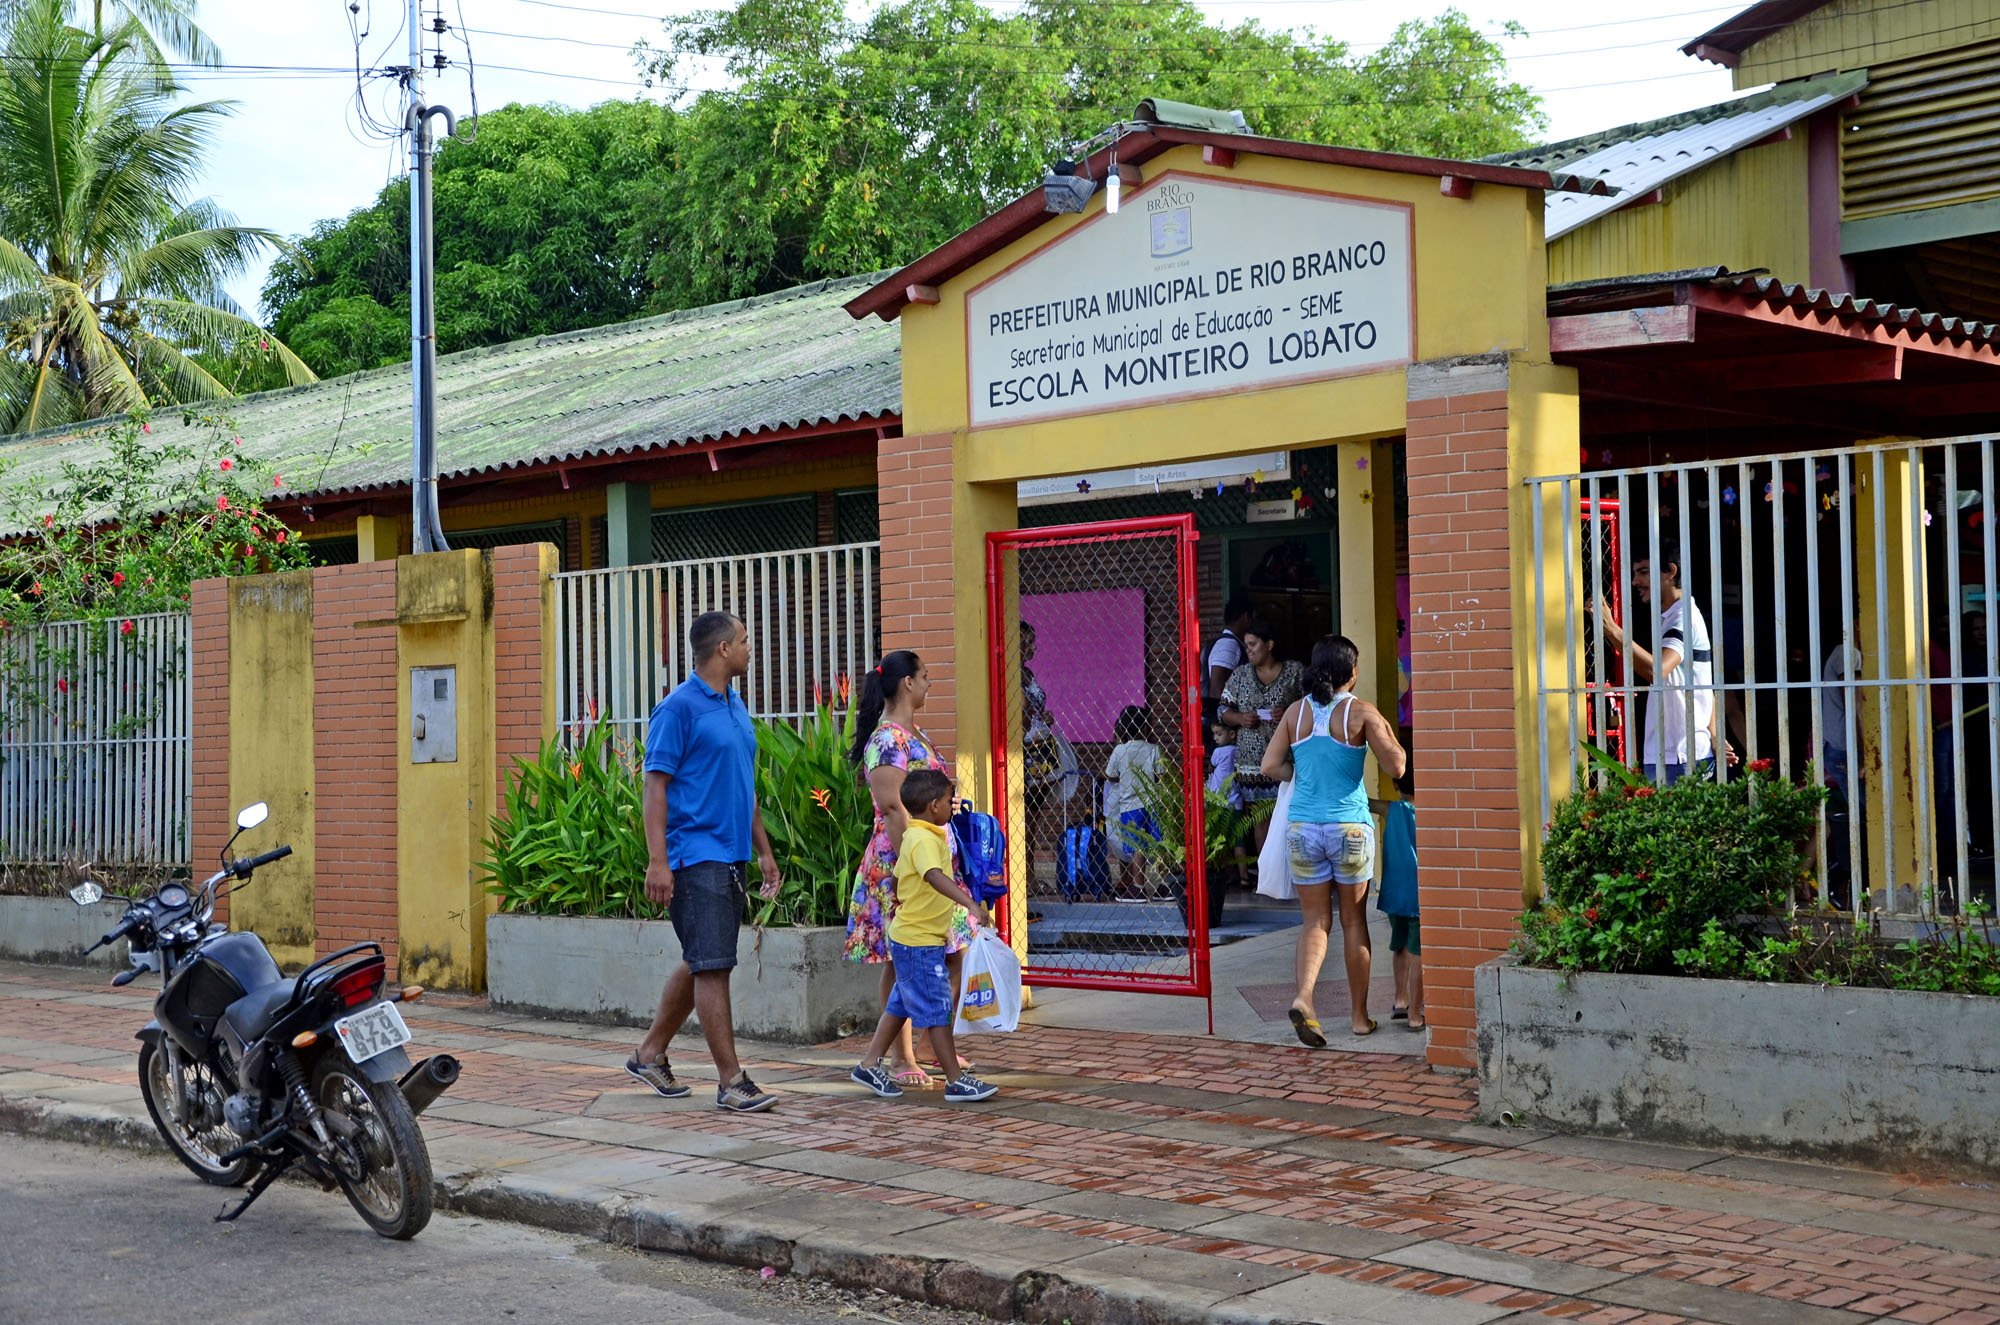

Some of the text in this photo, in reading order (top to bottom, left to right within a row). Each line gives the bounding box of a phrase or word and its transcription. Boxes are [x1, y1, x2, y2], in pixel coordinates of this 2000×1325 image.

[1160, 183, 1180, 198] RIO
[1147, 191, 1195, 212] BRANCO
[989, 240, 1386, 336] PREFEITURA MUNICIPAL DE RIO BRANCO
[1010, 335, 1085, 369] Secretaria
[1093, 318, 1163, 356] Municipal
[1172, 318, 1189, 340] de
[1195, 304, 1273, 337] Educação
[1300, 291, 1343, 320] SEME
[989, 320, 1377, 408] ESCOLA MONTEIRO LOBATO
[1138, 473, 1155, 482] Sala
[1167, 471, 1187, 480] Artes
[1257, 507, 1287, 516] Secretaria
[980, 988, 992, 1002] 10
[355, 1027, 404, 1057] 9743
